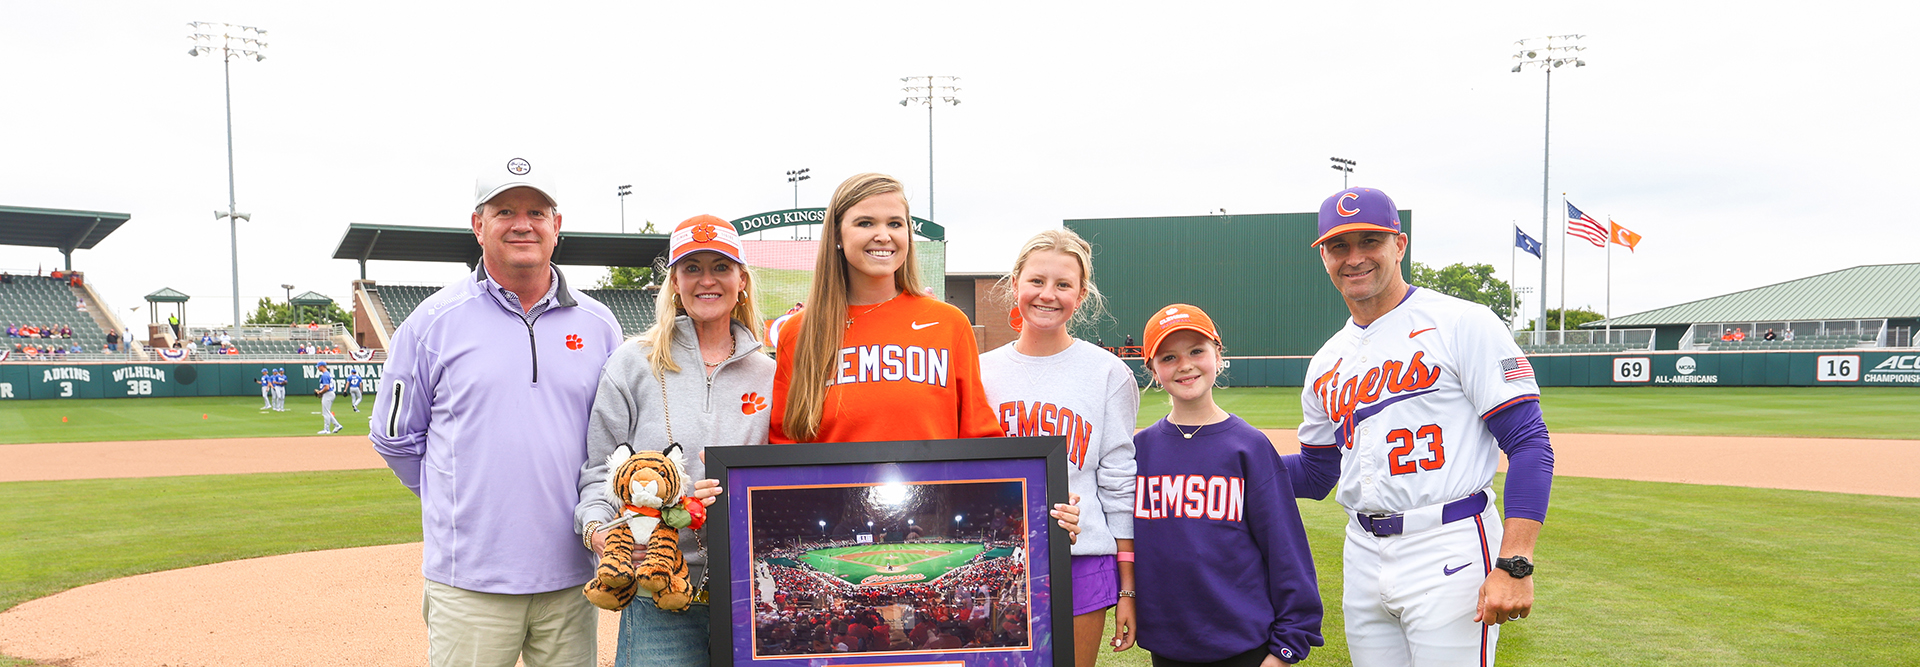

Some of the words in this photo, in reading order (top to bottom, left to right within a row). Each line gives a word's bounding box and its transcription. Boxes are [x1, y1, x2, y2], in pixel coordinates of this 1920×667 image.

[1336, 192, 1360, 217] C
[741, 214, 781, 231] DOUG
[783, 210, 827, 223] KINGS
[434, 291, 467, 310] Columbia
[43, 367, 90, 383] ADKINS
[112, 366, 165, 382] WILHELM
[826, 344, 949, 387] EMSON
[1621, 362, 1642, 377] 69
[1827, 360, 1850, 376] 16
[126, 380, 152, 395] 38
[1655, 375, 1718, 383] ALL-AMERICANS
[59, 382, 73, 397] 3
[1313, 351, 1441, 450] Tigers
[1000, 400, 1092, 471] EMSON
[1386, 423, 1445, 476] 23
[1134, 474, 1245, 522] LEMSON
